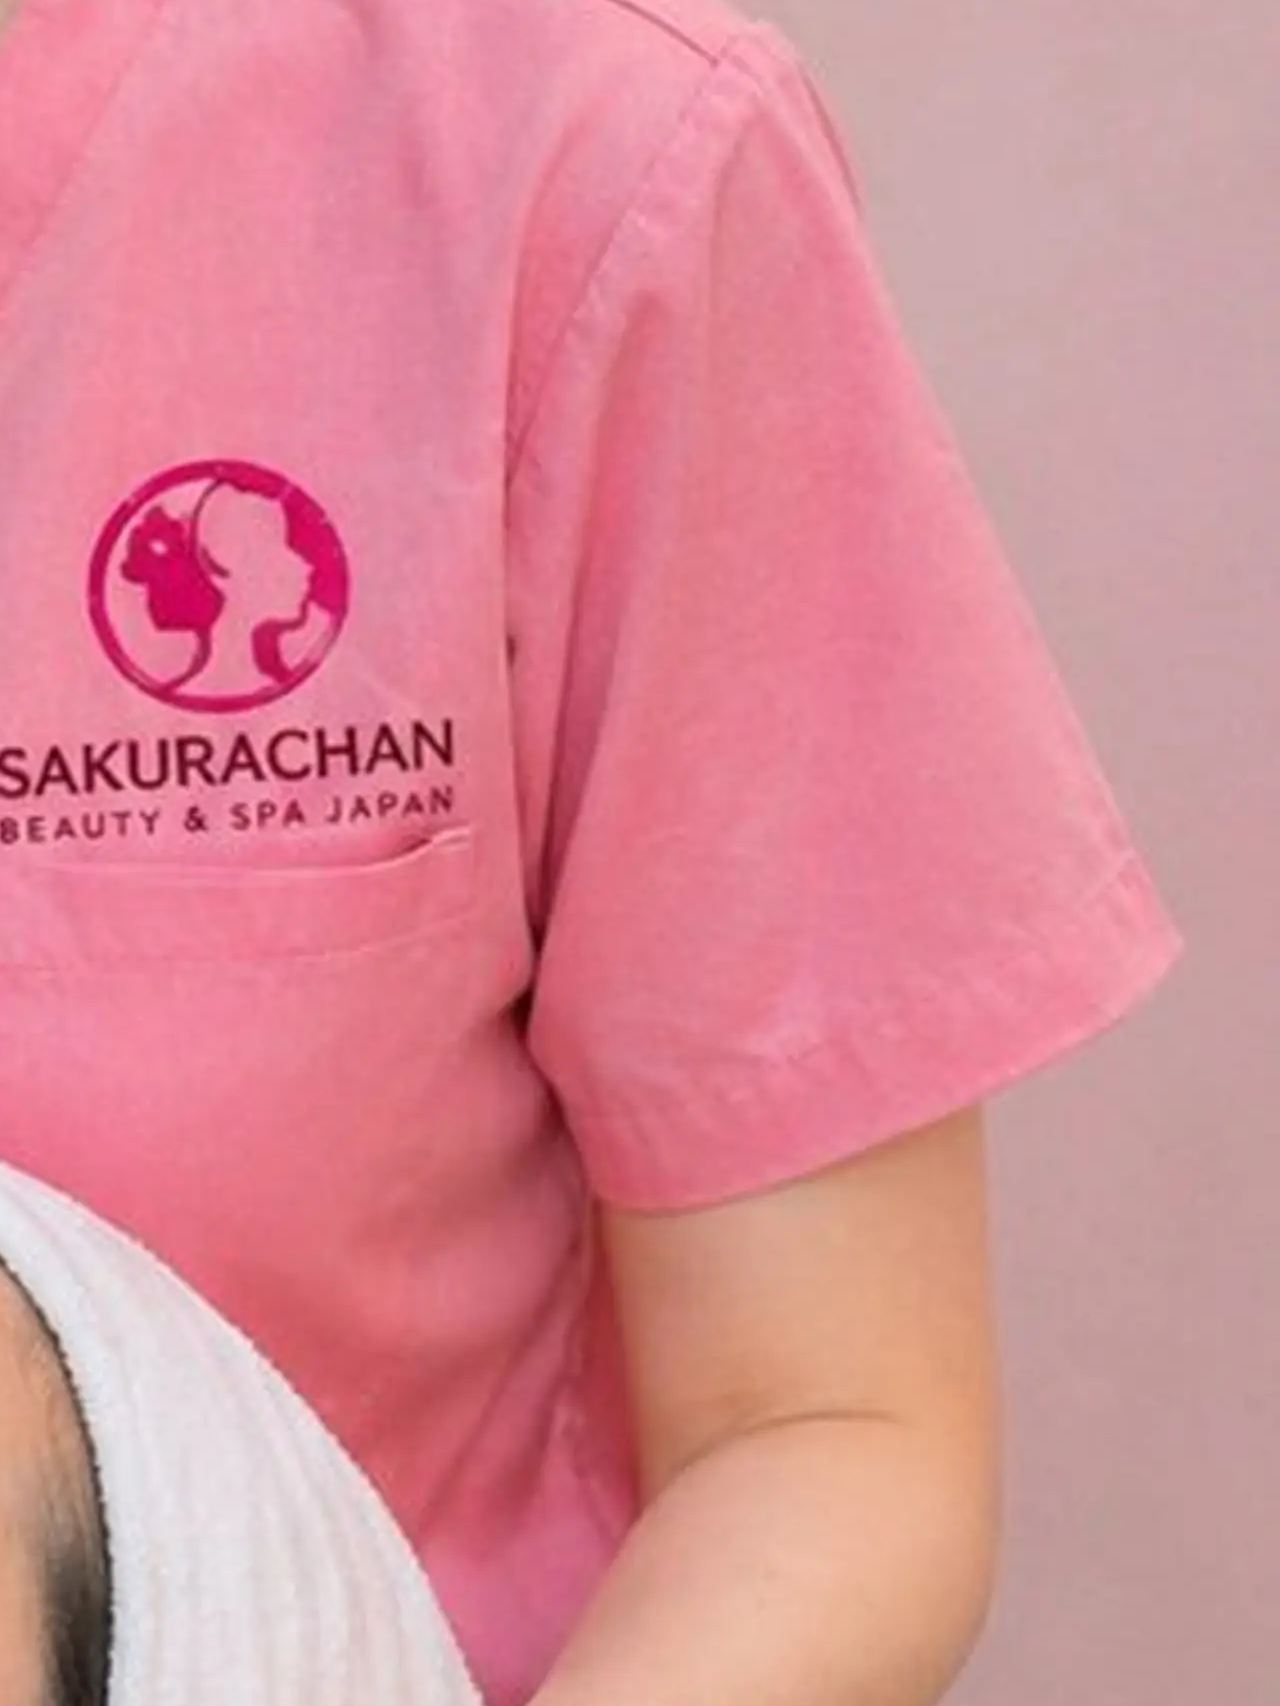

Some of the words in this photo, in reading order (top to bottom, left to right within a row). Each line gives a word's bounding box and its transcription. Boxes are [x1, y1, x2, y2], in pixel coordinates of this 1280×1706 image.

[184, 805, 209, 834] &
[229, 798, 307, 831] SPA
[325, 785, 454, 824] JAPAN
